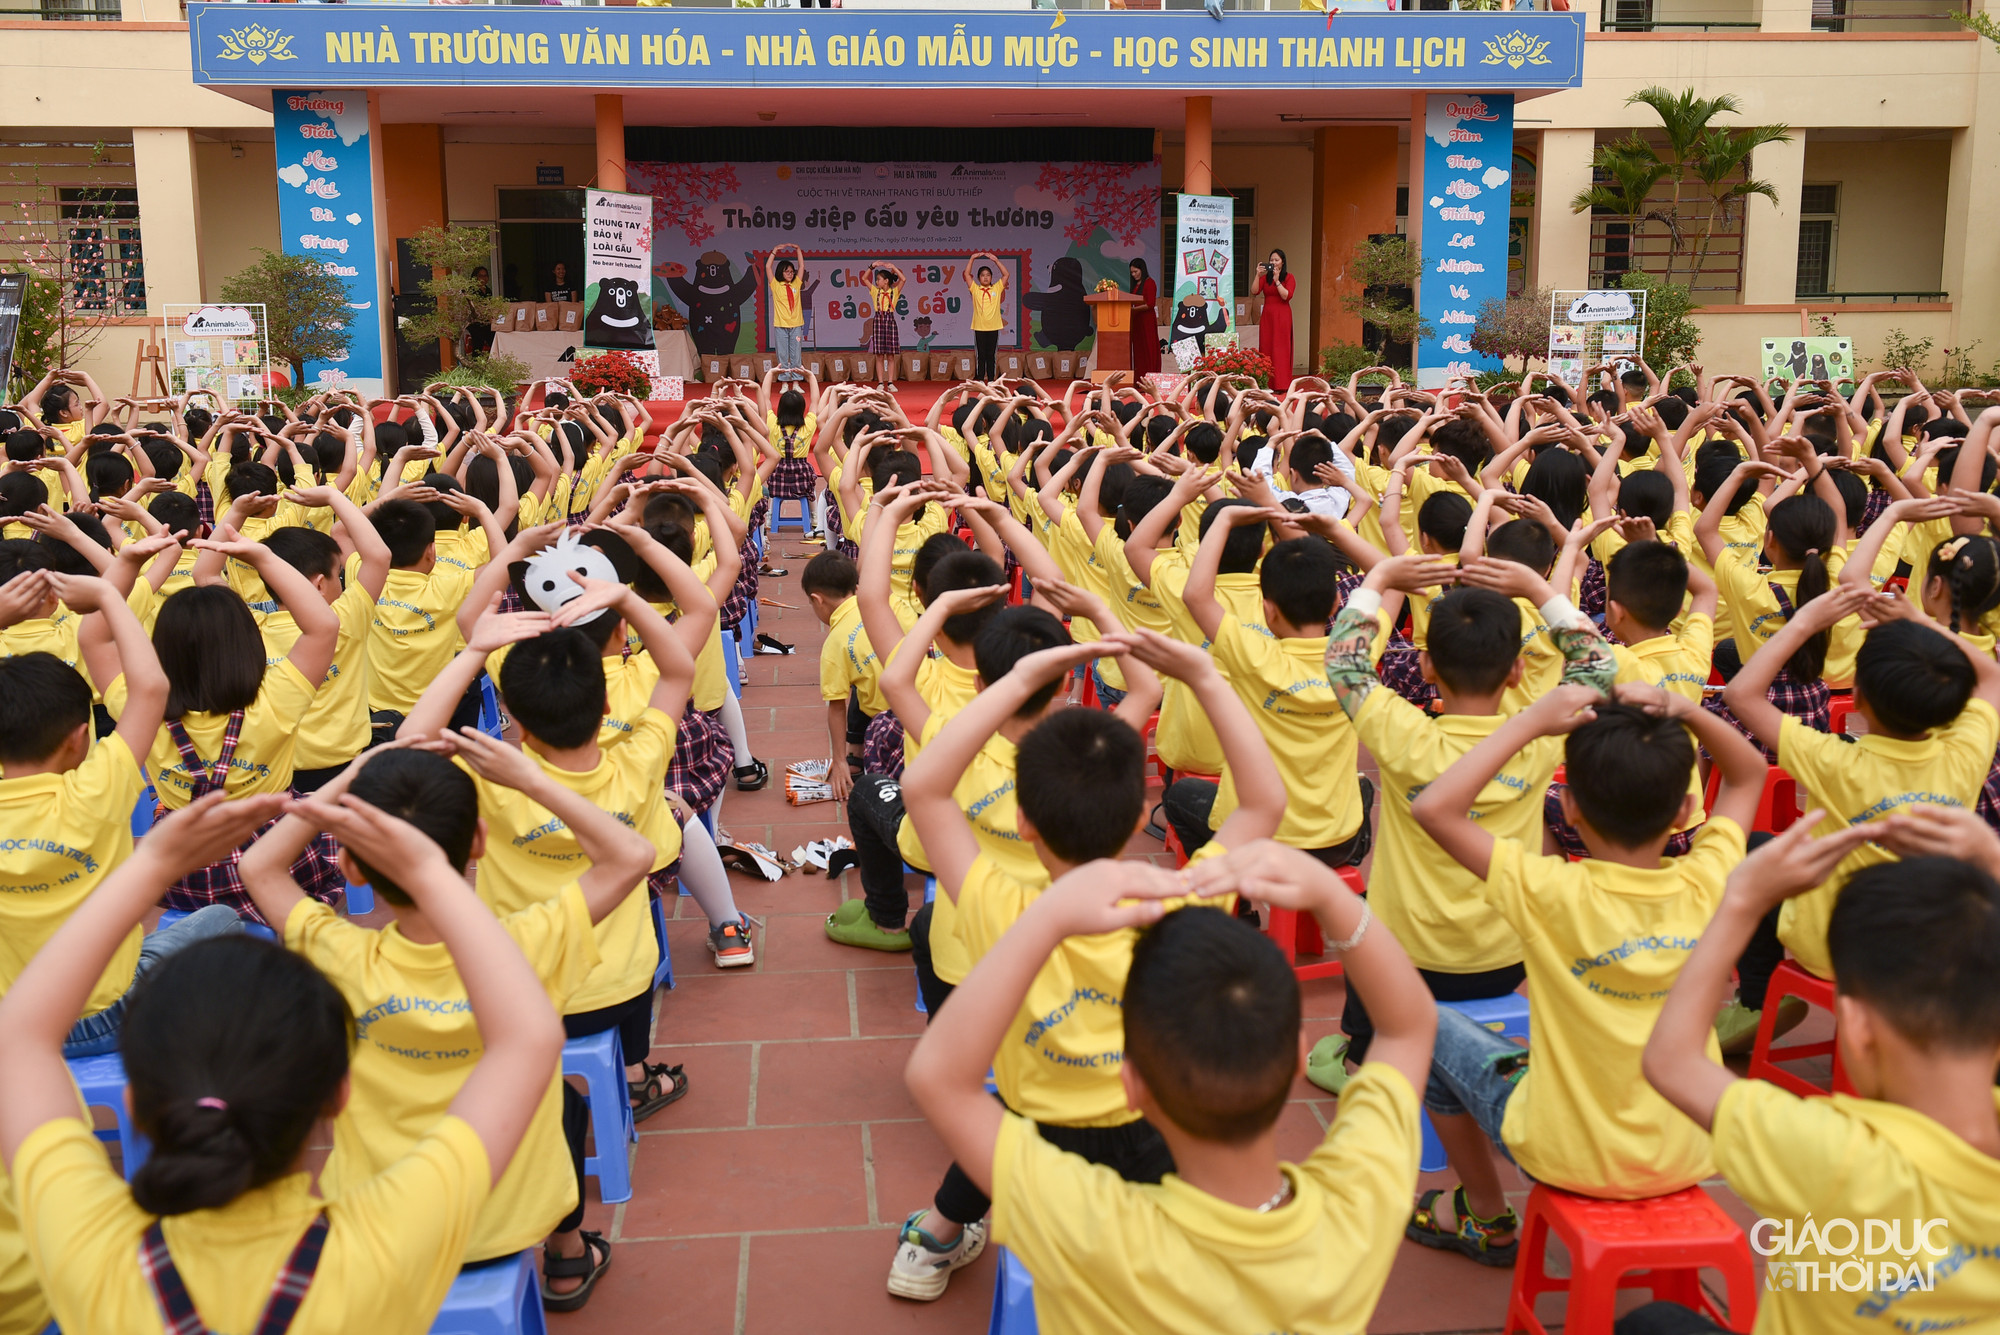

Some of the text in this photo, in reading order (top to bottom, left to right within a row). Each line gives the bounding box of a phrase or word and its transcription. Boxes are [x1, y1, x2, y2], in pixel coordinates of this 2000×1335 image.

[326, 25, 400, 63] NHÀ
[410, 24, 548, 64] TRƯỜNG
[560, 27, 629, 65] VĂN
[642, 27, 710, 66] HÓA
[746, 28, 816, 66] NHÀ
[828, 28, 905, 66] GIÁO
[918, 23, 992, 67] MẪU
[1005, 33, 1078, 74] MỰC
[1091, 50, 1101, 58] -
[1114, 36, 1178, 74] HỌC
[1190, 36, 1267, 68] SINH
[1279, 37, 1384, 68] THANH
[1396, 37, 1465, 74] LỊCH
[287, 96, 344, 115] Trường
[1446, 100, 1499, 121] Quyết
[300, 122, 336, 140] Tiểu
[1449, 128, 1483, 143] Tâm
[1446, 155, 1482, 169] Thực
[893, 170, 904, 179] HAI
[305, 177, 341, 199] Hai
[797, 187, 822, 198] CUỘC
[825, 188, 839, 197] THI
[855, 188, 886, 197] TRANH
[888, 188, 919, 197] TRANG
[921, 186, 935, 197] TRÍ
[937, 187, 955, 197] BƯU
[958, 185, 983, 197] THIẾP
[606, 201, 642, 211] AnimalsAsia
[310, 207, 336, 222] Bà
[722, 201, 1054, 232] Thông điệp Gấu yêu thương
[1440, 205, 1485, 226] Thắng
[593, 218, 641, 230] CHUNG TAY
[1189, 226, 1207, 235] Thông
[593, 229, 622, 242] BẢO VỆ
[1448, 232, 1475, 248] Lợi
[300, 234, 349, 253] Trưng
[593, 242, 632, 253] LOÀI GẤU
[1437, 259, 1484, 274] Nhiệm
[912, 264, 955, 285] tay
[1450, 285, 1470, 301] Vụ
[828, 295, 871, 320] Bảo
[918, 288, 960, 315] Gấu
[1588, 305, 1628, 313] AnimalsAsia
[205, 320, 249, 328] AnimalsAsia
[414, 996, 451, 1017] HỌC
